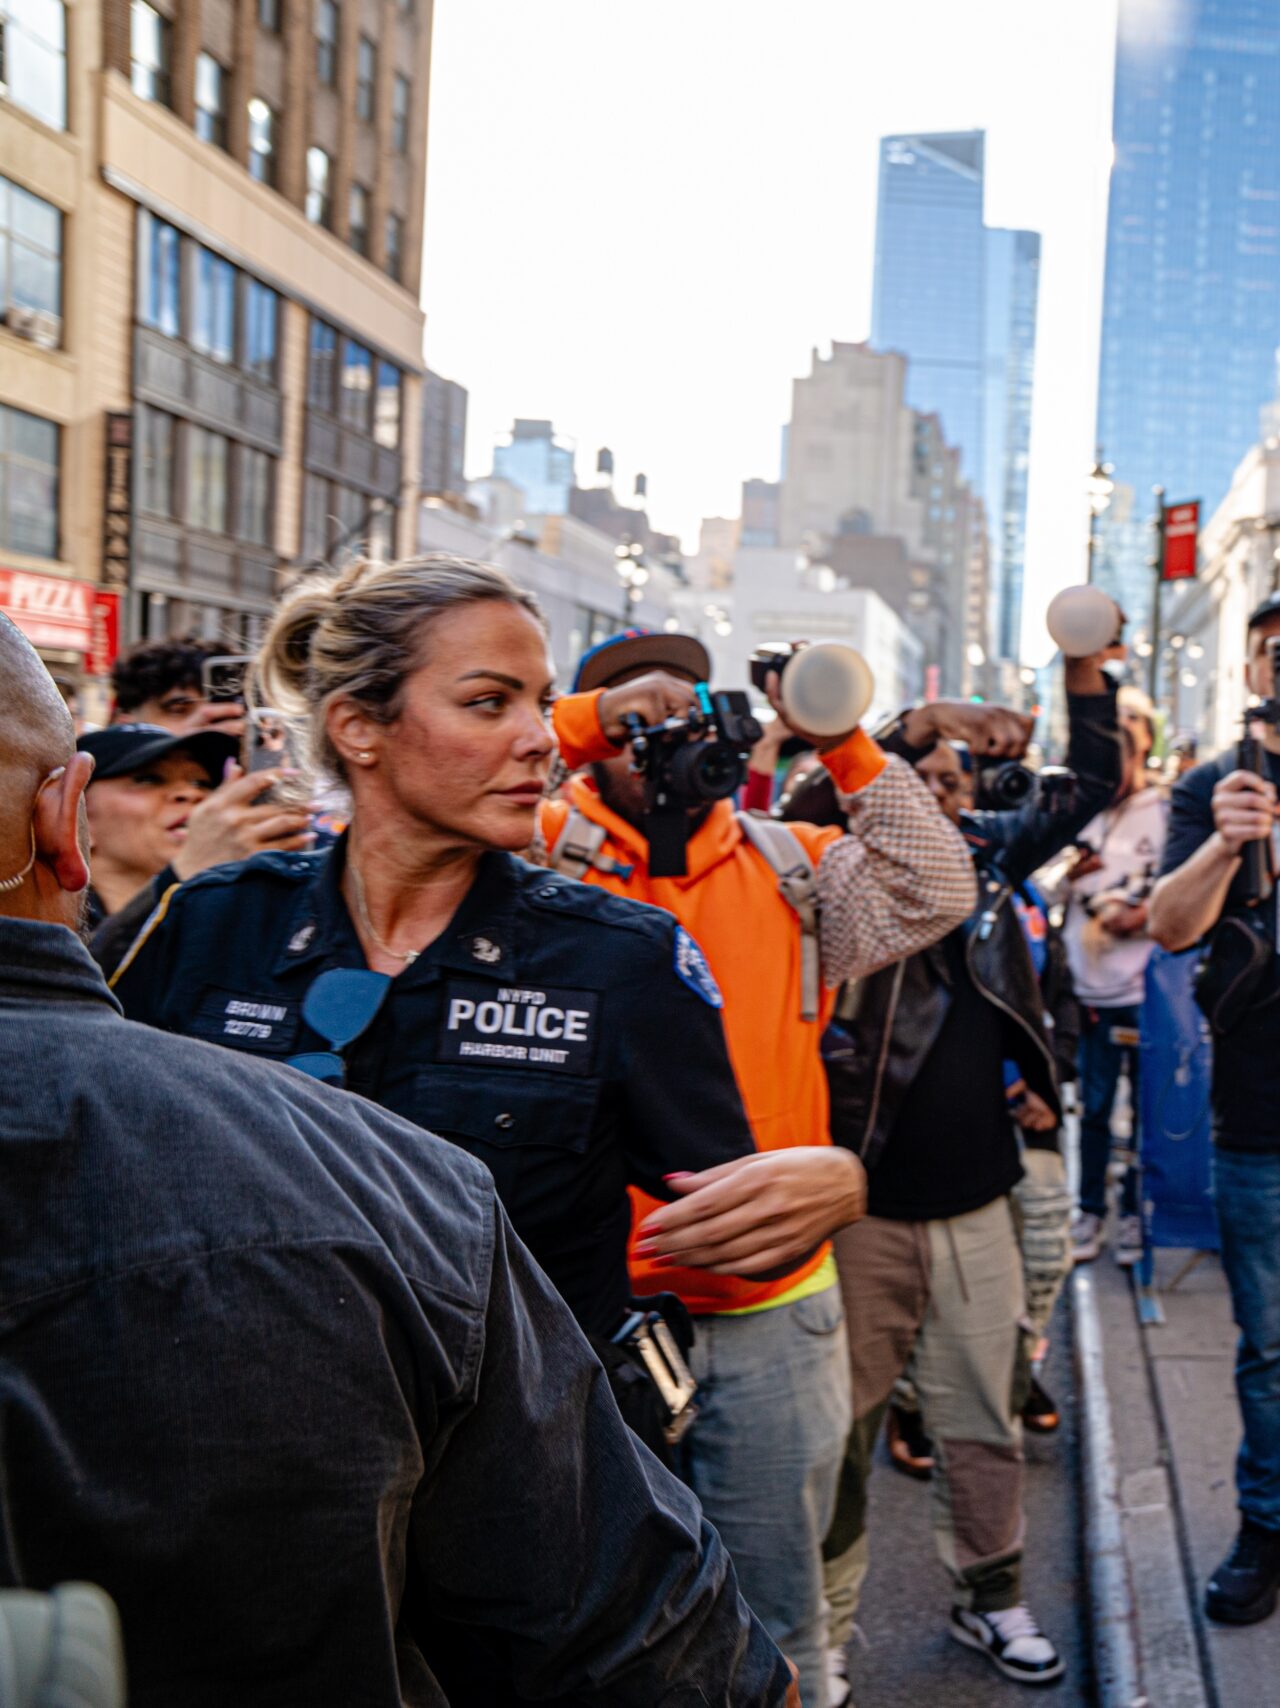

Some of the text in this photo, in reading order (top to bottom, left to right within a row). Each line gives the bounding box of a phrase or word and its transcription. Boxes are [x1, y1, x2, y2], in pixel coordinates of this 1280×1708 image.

[10, 573, 87, 617] PIZZA
[497, 988, 546, 1005] NYPD
[224, 1000, 288, 1022] BROWN
[447, 998, 590, 1042] POLICE
[459, 1041, 570, 1065] HARBOR UNIT
